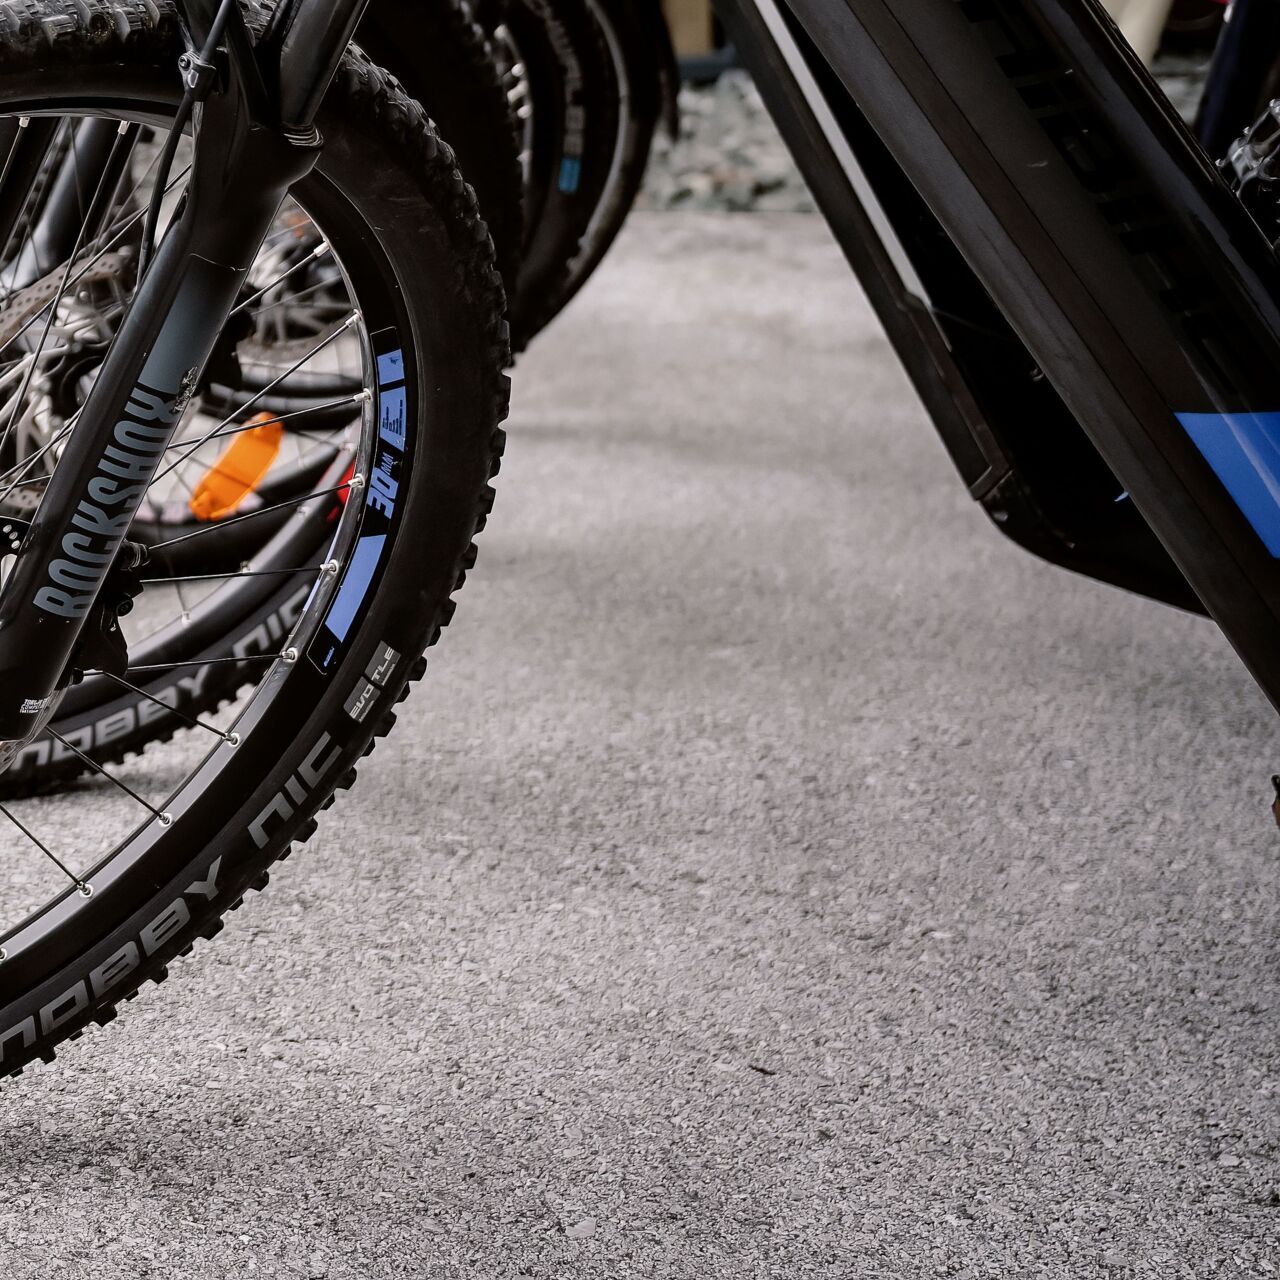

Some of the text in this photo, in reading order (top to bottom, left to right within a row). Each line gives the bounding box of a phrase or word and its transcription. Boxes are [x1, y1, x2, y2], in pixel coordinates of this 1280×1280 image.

[34, 380, 178, 618] ROCKSHOX
[9, 583, 310, 772] NOBBY NIC
[348, 683, 375, 719] EVO
[371, 646, 396, 681] TLE
[247, 731, 345, 849] NIC
